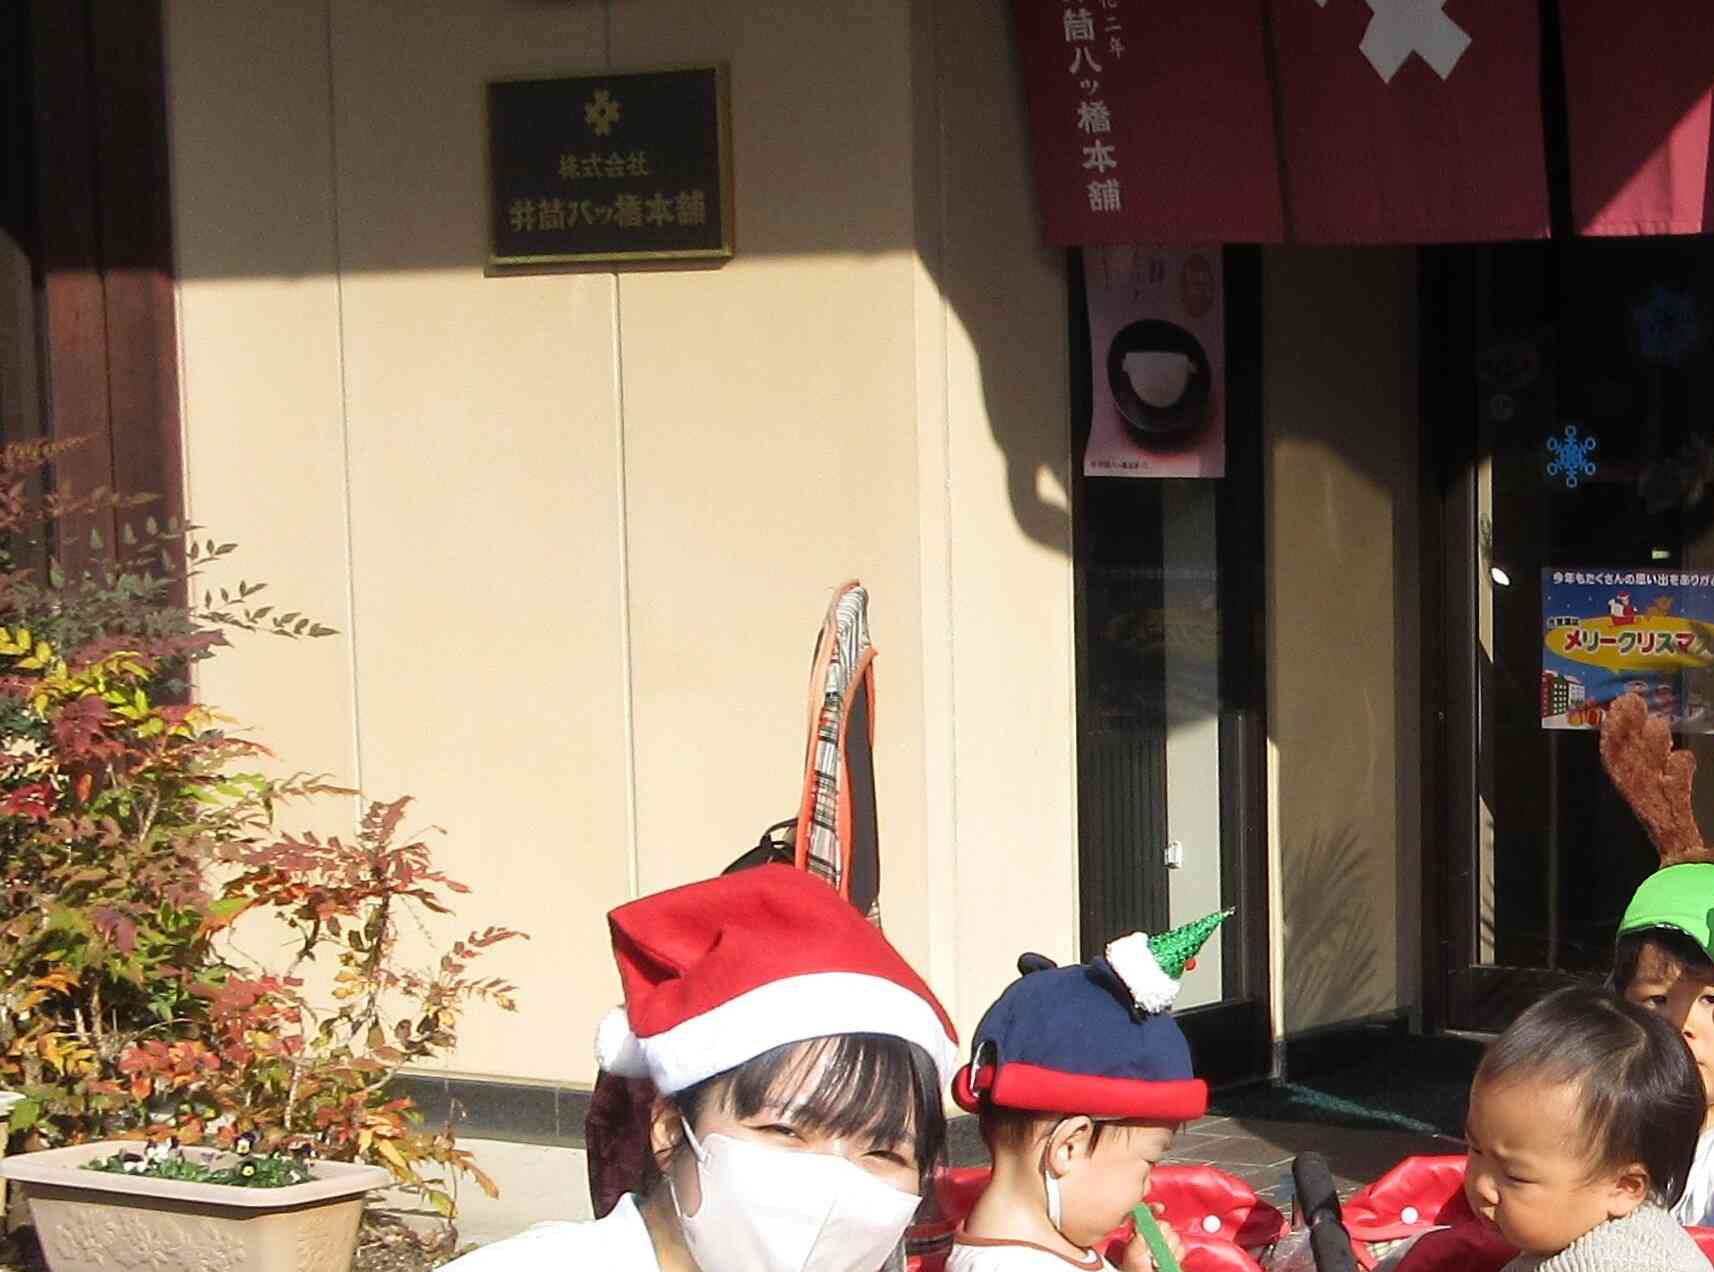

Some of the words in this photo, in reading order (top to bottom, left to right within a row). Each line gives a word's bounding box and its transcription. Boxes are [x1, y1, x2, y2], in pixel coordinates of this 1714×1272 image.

[558, 151, 650, 178] 株式会社
[1062, 0, 1121, 212] 筒八ッ橋本舗
